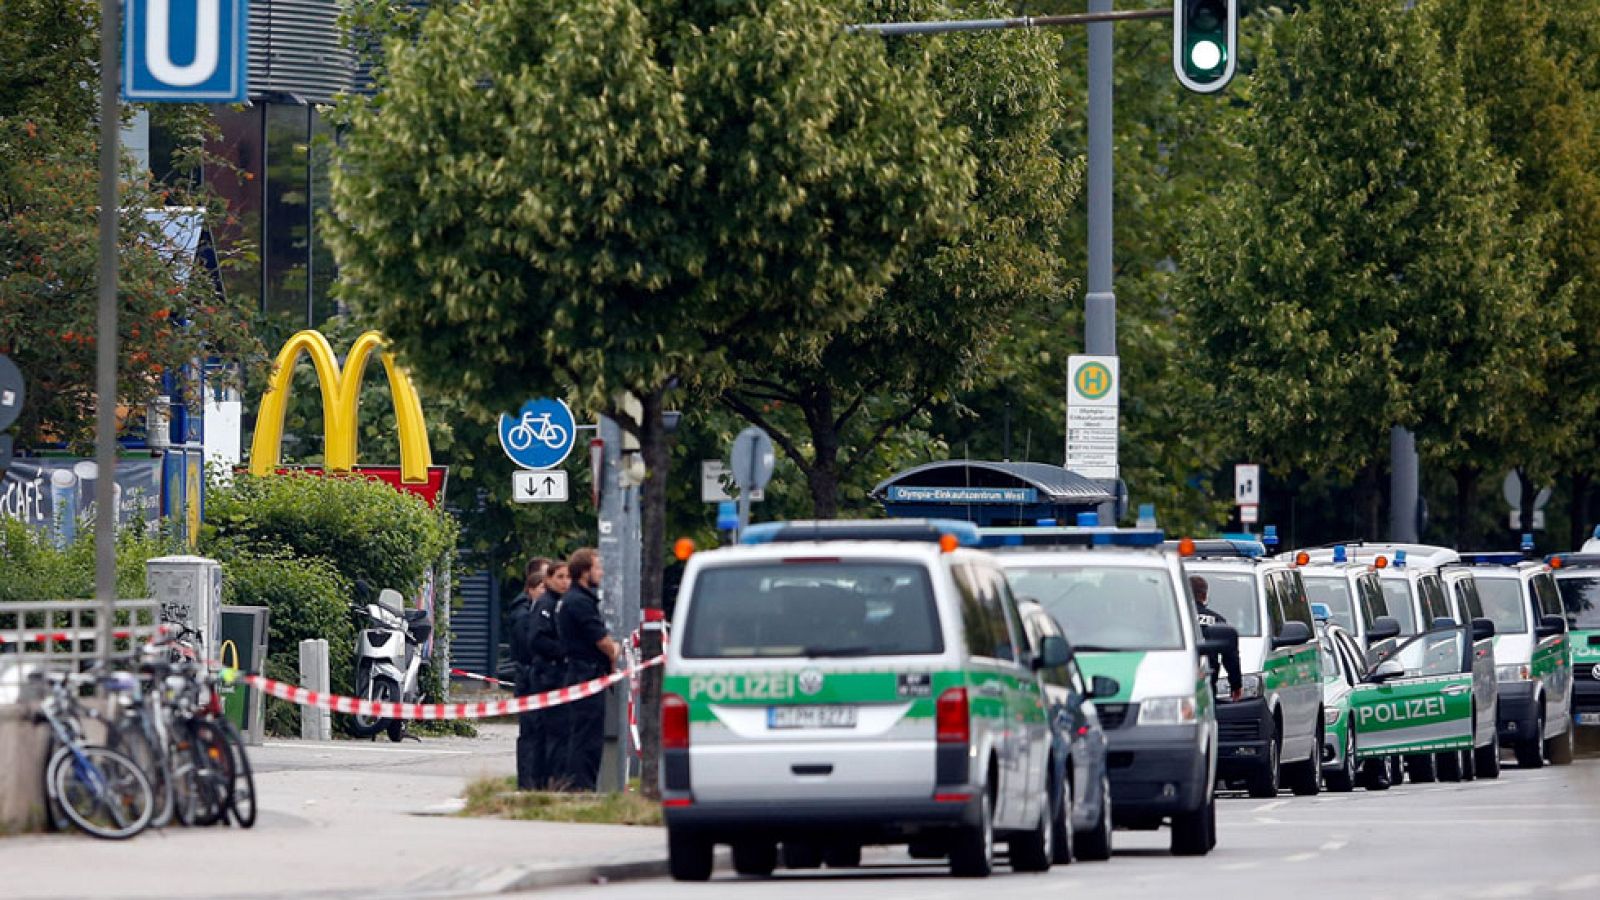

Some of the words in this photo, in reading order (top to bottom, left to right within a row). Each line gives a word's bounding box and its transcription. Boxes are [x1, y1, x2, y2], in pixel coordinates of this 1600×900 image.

[146, 0, 219, 86] U
[689, 673, 795, 700] POLIZEI
[1359, 695, 1446, 725] POLIZEI
